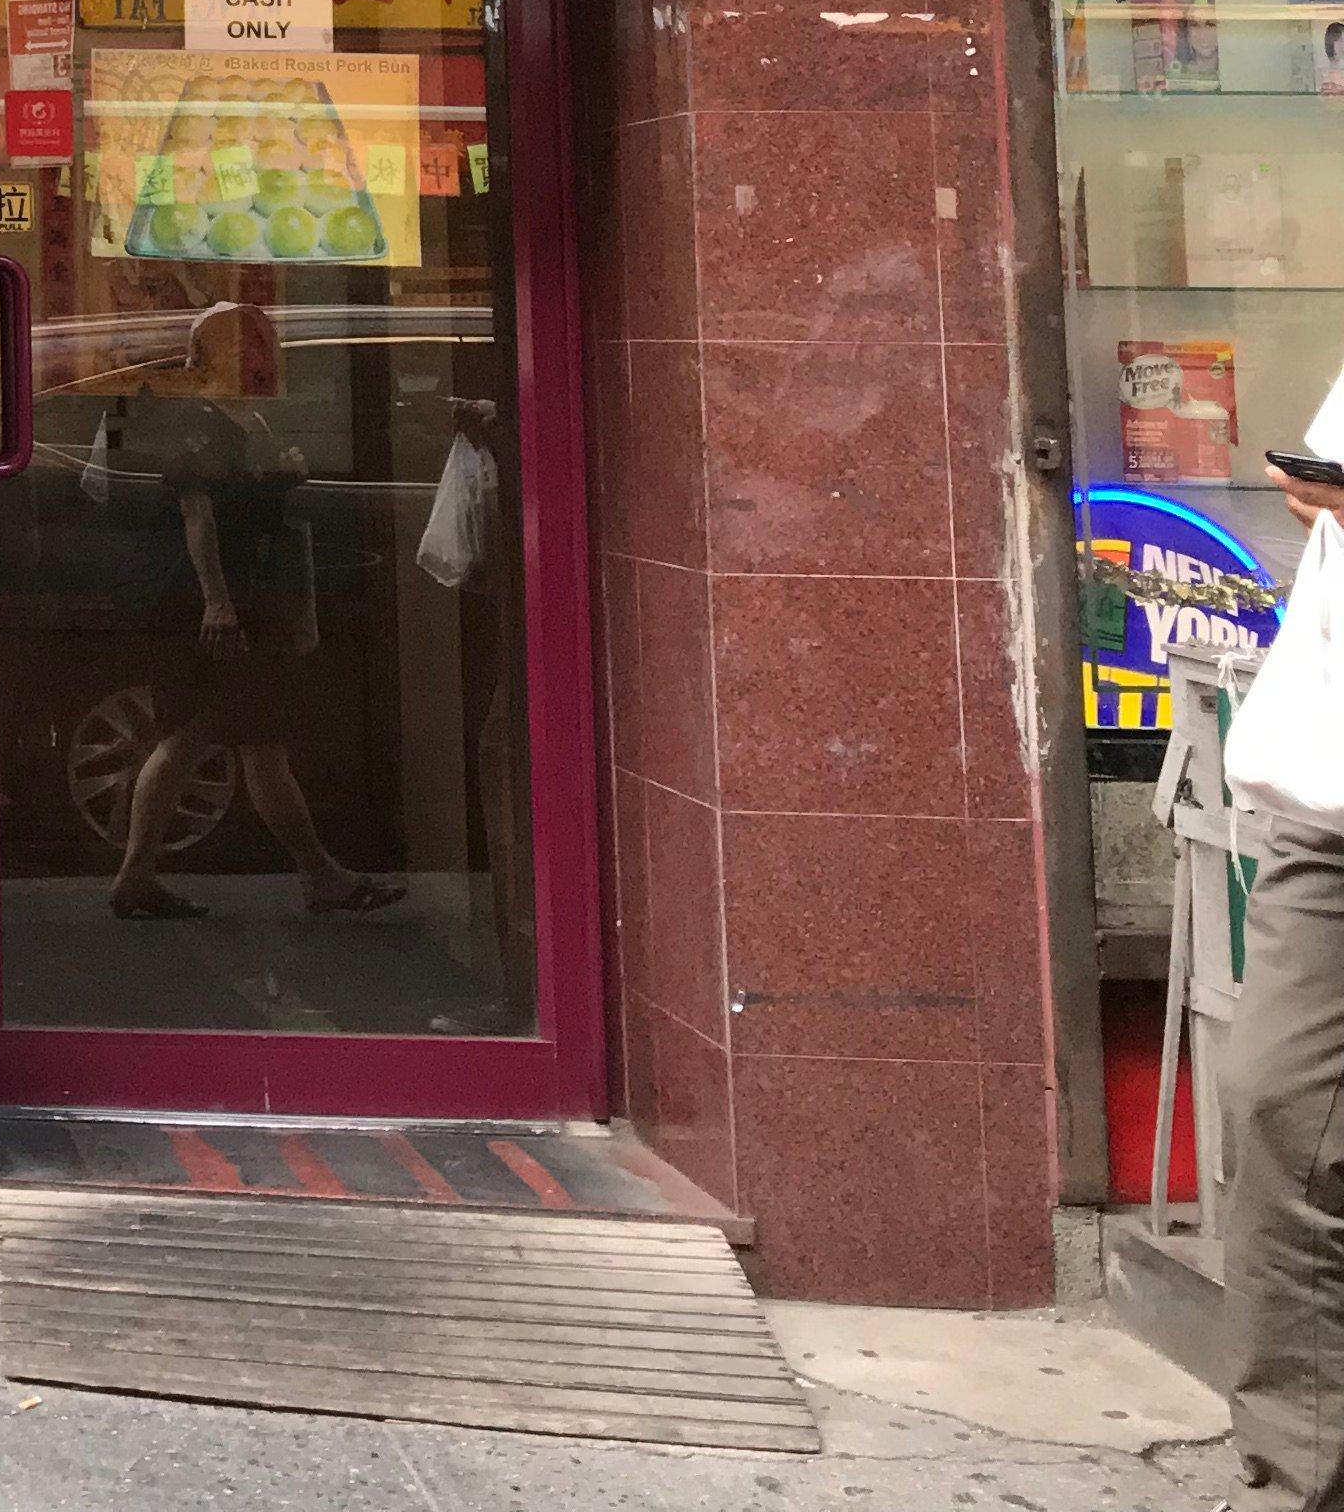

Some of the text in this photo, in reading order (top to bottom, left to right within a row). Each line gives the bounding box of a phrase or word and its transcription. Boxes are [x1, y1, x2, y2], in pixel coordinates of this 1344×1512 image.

[227, 20, 292, 39] ONLY
[230, 57, 279, 71] Baked
[285, 58, 331, 72] Roast
[336, 58, 372, 72] Pork
[379, 59, 410, 73] Bun
[1124, 363, 1170, 383] Move
